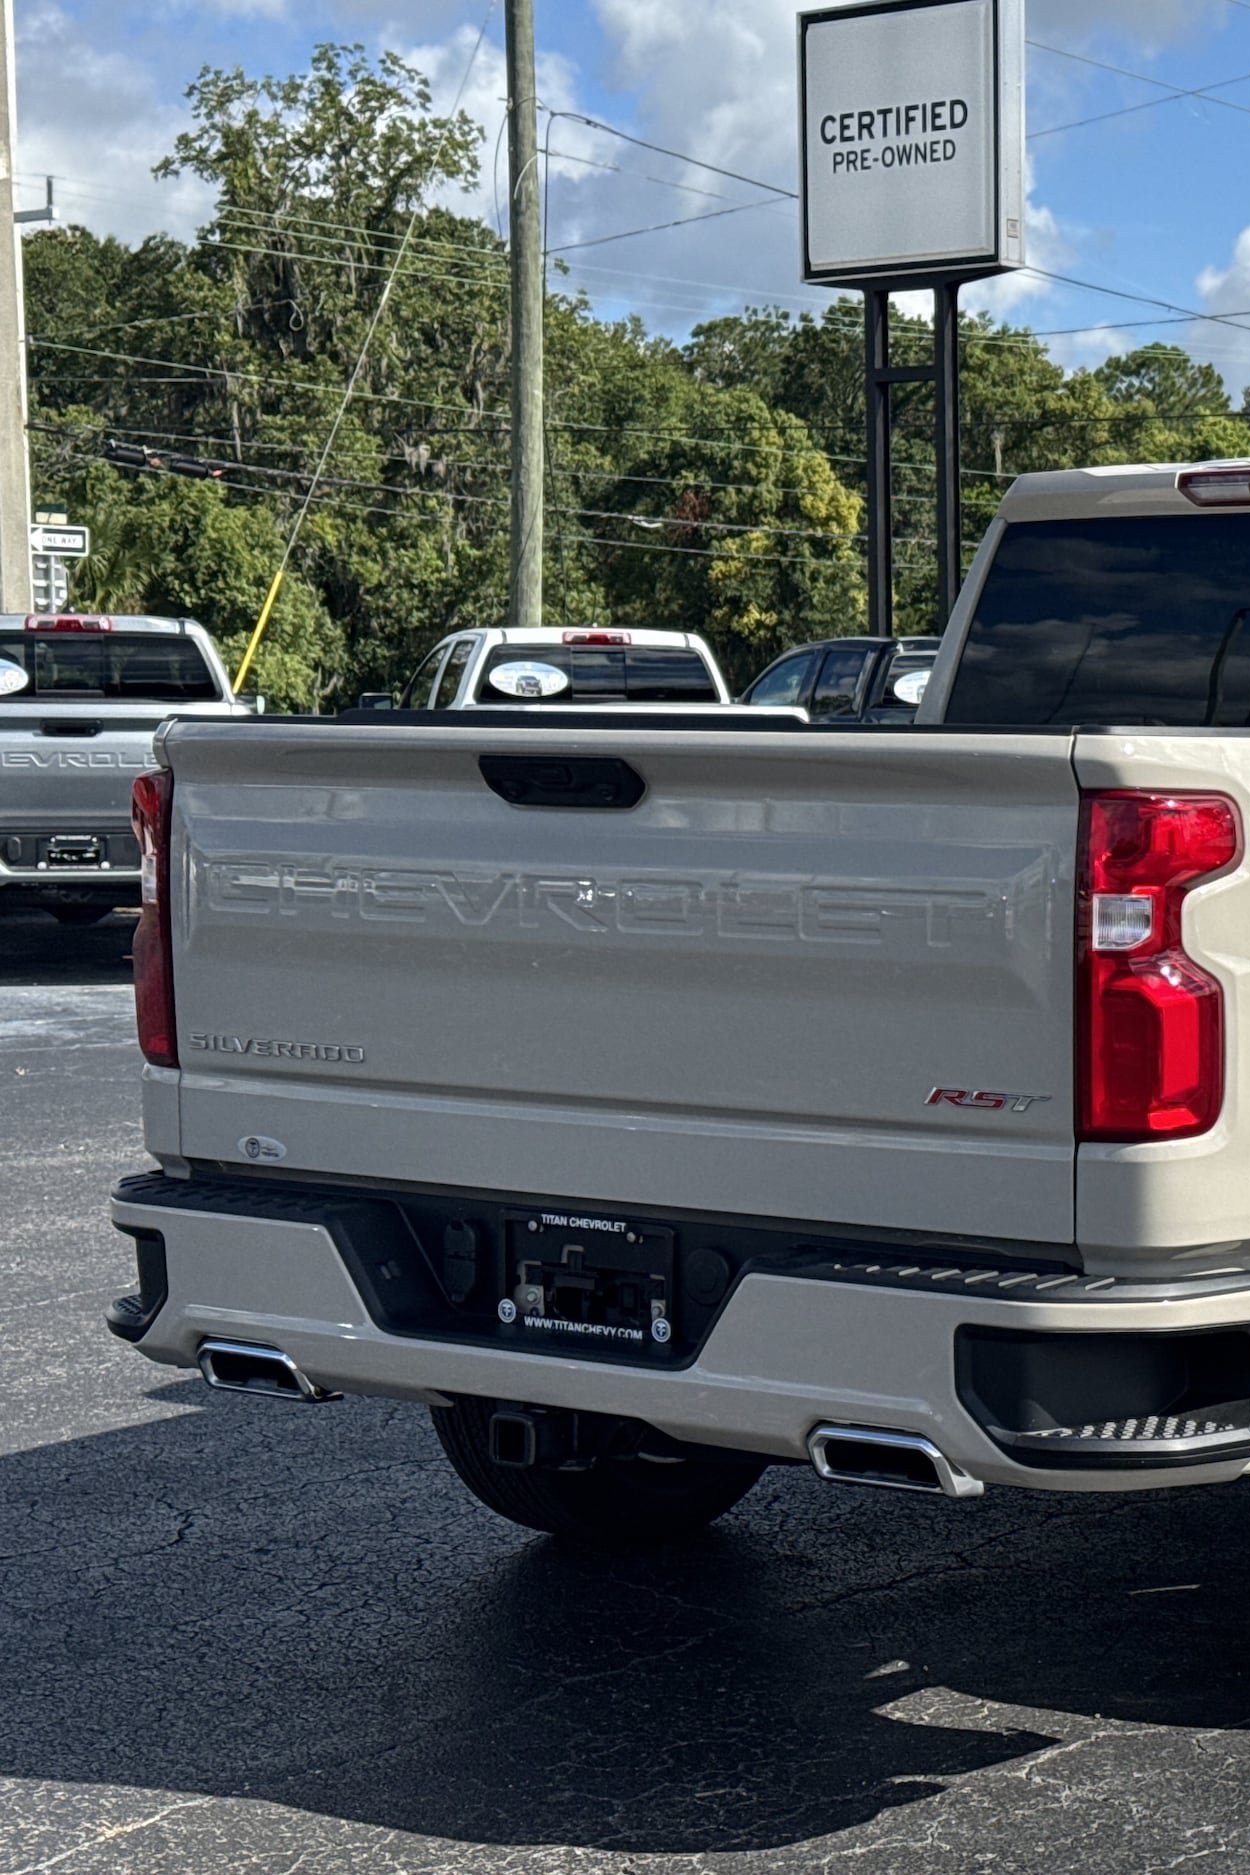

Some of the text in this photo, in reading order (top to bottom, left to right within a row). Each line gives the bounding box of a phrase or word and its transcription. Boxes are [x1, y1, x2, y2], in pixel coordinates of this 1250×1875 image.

[820, 99, 968, 145] CERTIFIED
[832, 139, 956, 174] PRE-OWNED
[42, 533, 76, 545] ONE WAY
[206, 859, 991, 949] CHEVROLET
[188, 1032, 365, 1063] SILVERADO
[923, 1086, 1052, 1113] RST
[541, 1213, 627, 1233] TITAN CHEVROLET
[523, 1315, 643, 1341] WWW.TITANCHEVY.COM
